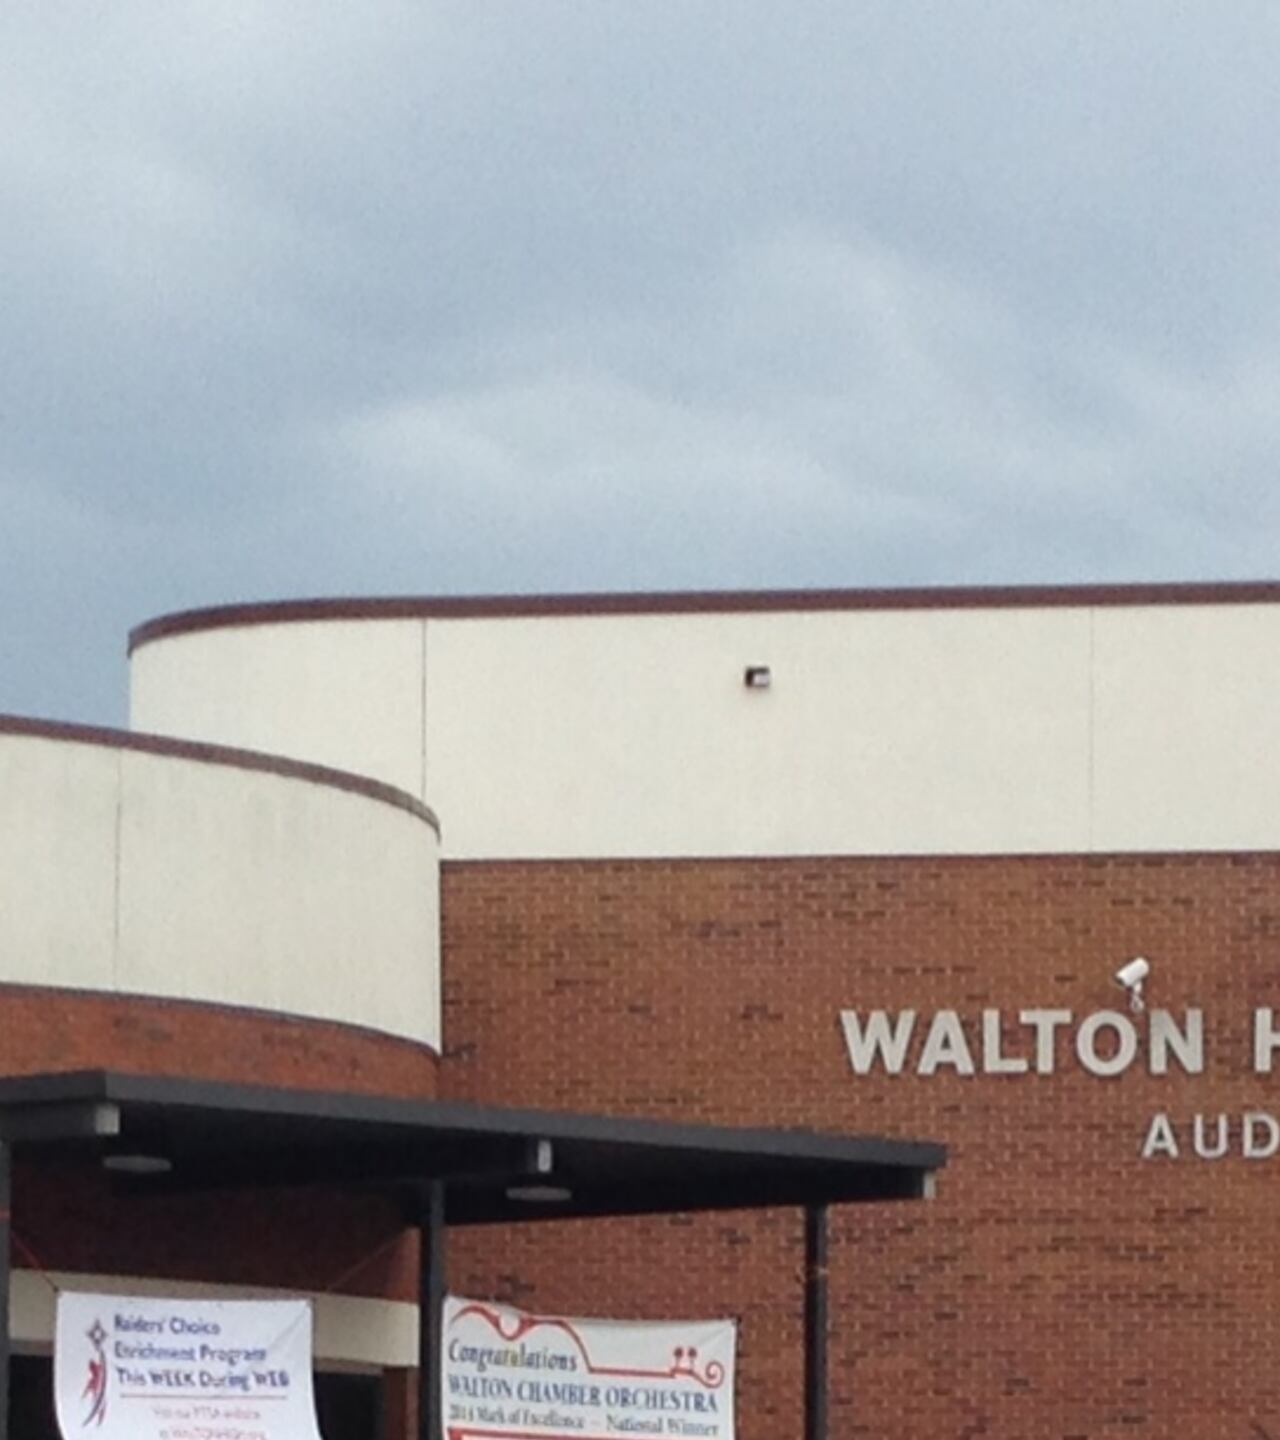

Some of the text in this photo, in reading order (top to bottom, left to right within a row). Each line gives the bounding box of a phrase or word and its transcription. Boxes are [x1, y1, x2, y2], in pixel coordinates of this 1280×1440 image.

[839, 1007, 1205, 1077] WALTON
[169, 1316, 221, 1335] Choice
[114, 1340, 267, 1367] Enrichment Program
[115, 1365, 147, 1386] This
[199, 1369, 251, 1392] During
[447, 1373, 719, 1413] WALTON CHAMBER ORCHESTRA
[605, 1413, 664, 1434] National
